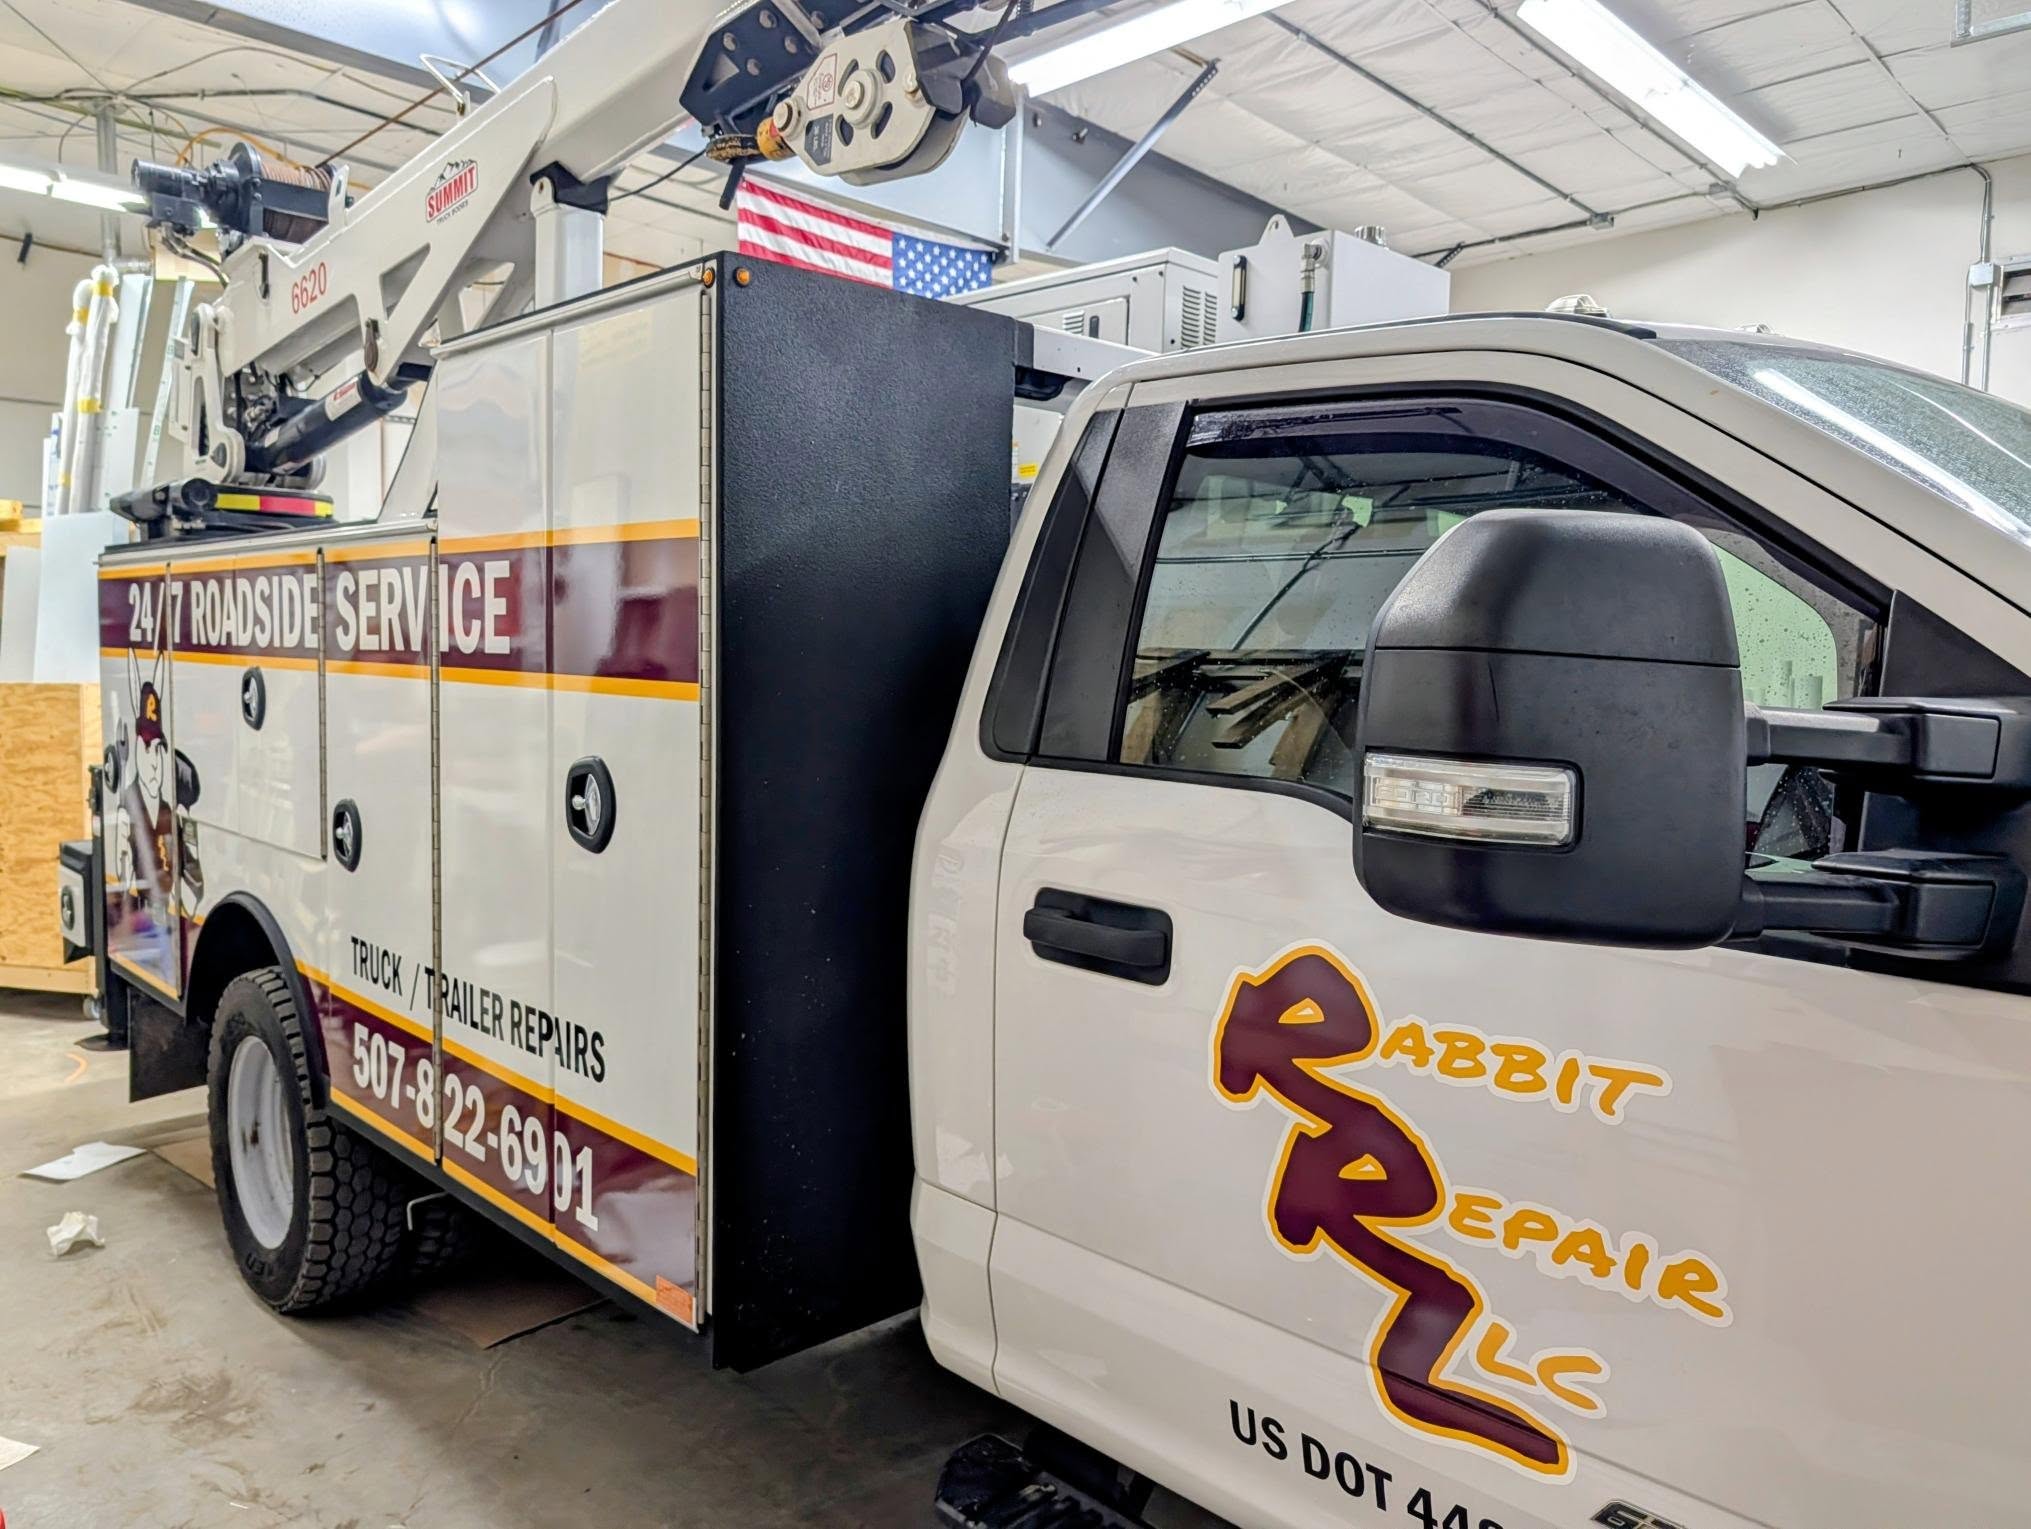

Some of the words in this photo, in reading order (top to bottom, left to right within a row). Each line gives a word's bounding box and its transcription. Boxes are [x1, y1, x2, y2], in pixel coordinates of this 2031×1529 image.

[427, 165, 475, 219] SUMMIT
[291, 261, 327, 314] 6620
[129, 580, 184, 656] 24/7
[190, 573, 320, 649] ROADSIDE
[335, 559, 511, 655] SERVICE
[351, 936, 402, 996] TRUCK
[424, 966, 504, 1041] TRAILER
[510, 999, 605, 1084] REPAIRS
[353, 1022, 599, 1232] 507-822-6901
[1229, 1399, 1288, 1461] US
[1301, 1432, 1393, 1512] DOT
[1406, 1487, 1504, 1529] 44
